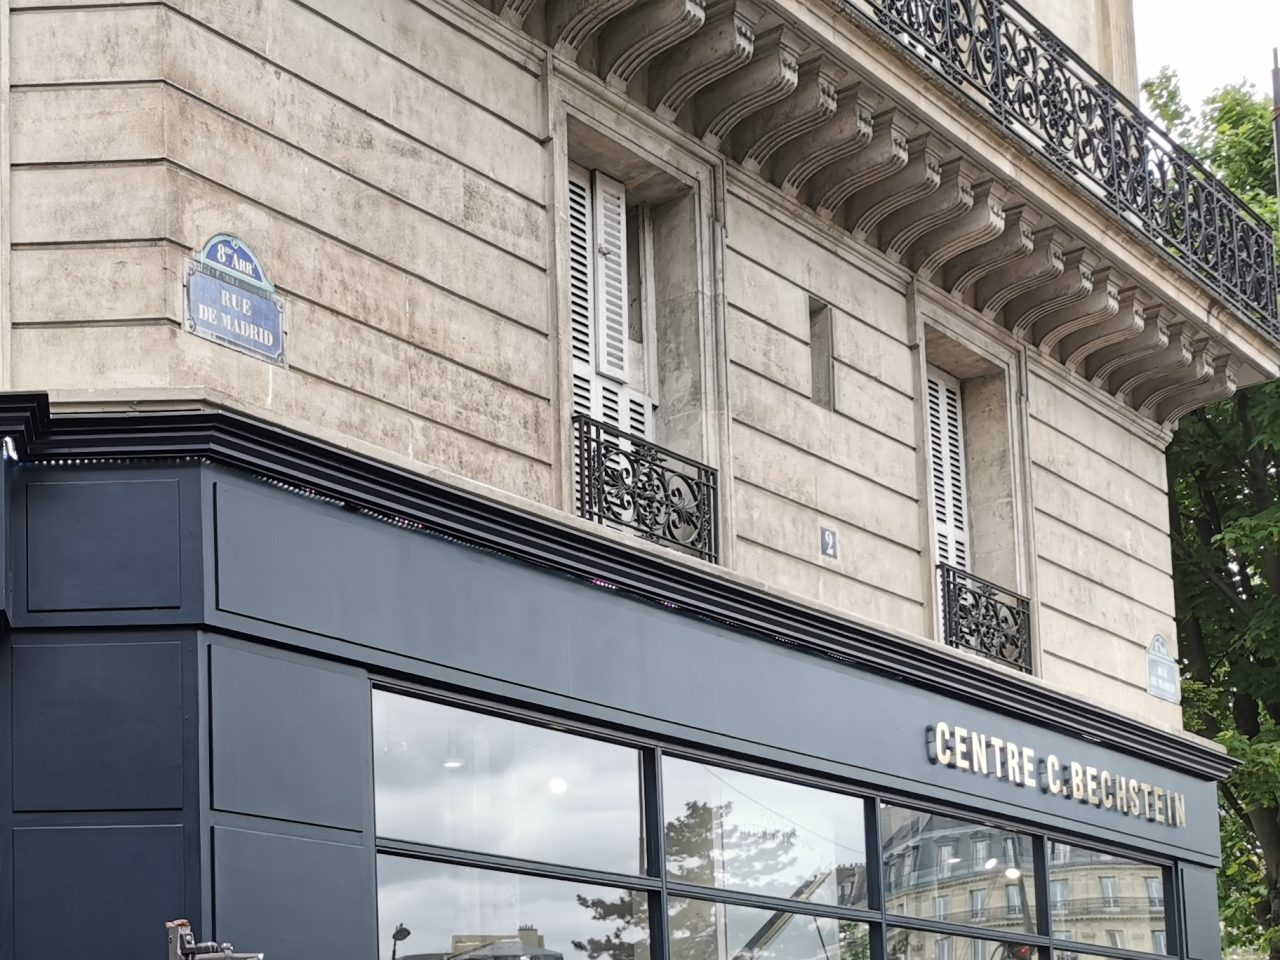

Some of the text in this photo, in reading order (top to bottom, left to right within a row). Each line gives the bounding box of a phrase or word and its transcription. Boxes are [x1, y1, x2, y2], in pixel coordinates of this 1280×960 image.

[221, 289, 252, 316] RUE
[198, 303, 273, 347] DE MADRID
[824, 530, 834, 556] 2
[935, 721, 1037, 788] CENTRE
